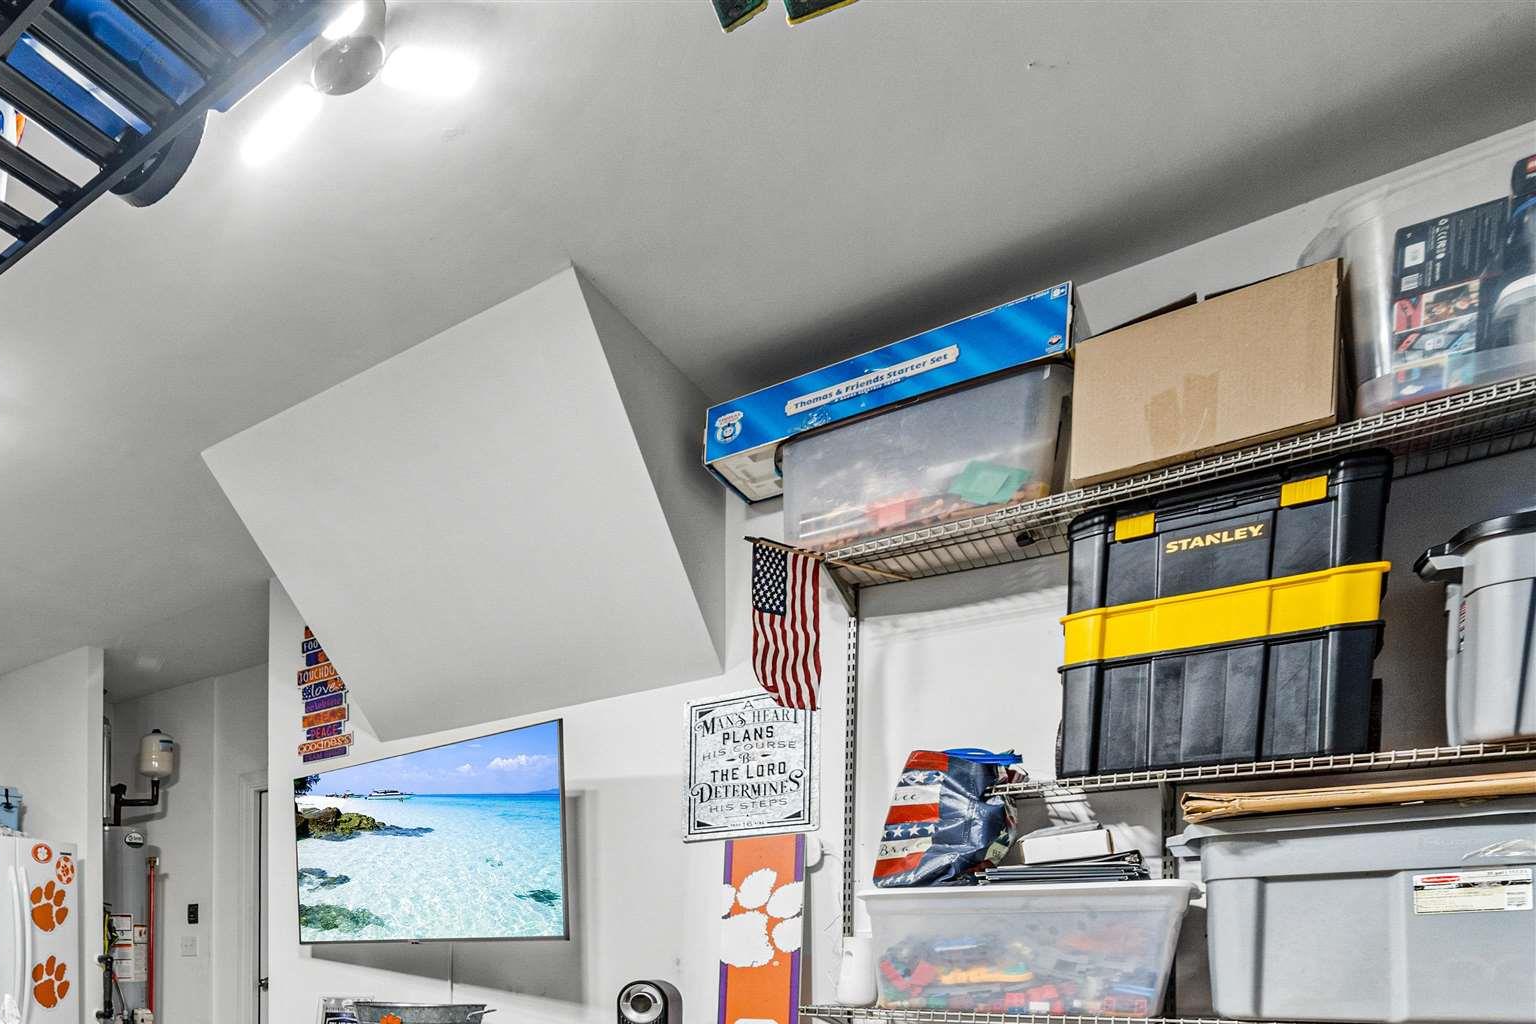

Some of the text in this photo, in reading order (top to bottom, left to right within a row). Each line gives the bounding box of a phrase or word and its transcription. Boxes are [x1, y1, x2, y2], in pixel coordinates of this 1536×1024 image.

[794, 391, 833, 410] Thomas
[835, 387, 843, 397] &
[845, 373, 885, 393] Friends
[886, 360, 928, 379] Starter
[930, 353, 949, 365] Set
[1166, 524, 1264, 553] STANLEY
[744, 700, 754, 709] A
[752, 708, 798, 723] HEART
[722, 725, 774, 745] PLANS
[702, 740, 797, 761] HIS COURSE
[710, 761, 787, 782] THE LORD
[690, 768, 804, 804] DETERMINES
[709, 799, 789, 813] HIS STEPS
